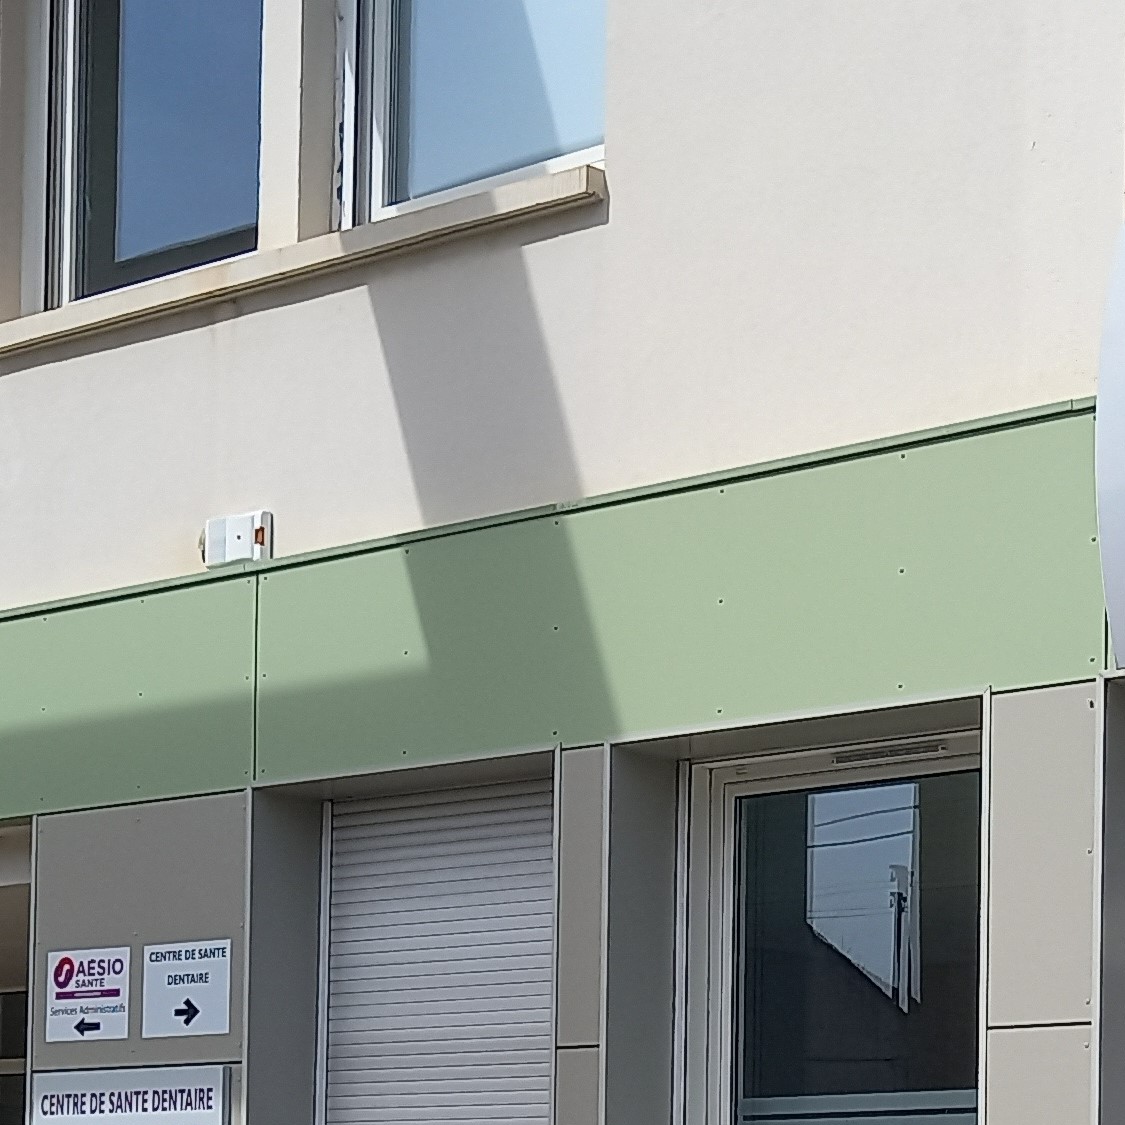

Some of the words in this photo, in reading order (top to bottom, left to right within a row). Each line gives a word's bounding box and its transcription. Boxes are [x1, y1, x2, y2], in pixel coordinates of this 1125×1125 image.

[149, 949, 183, 963] CENTRE
[184, 949, 197, 961] DE
[167, 972, 210, 986] DENTAIRE
[50, 1006, 78, 1016] Services
[41, 1092, 87, 1116] CENTRE
[89, 1092, 106, 1115] DE
[108, 1090, 149, 1114] SANTE
[151, 1087, 214, 1112] DENTAIRE
